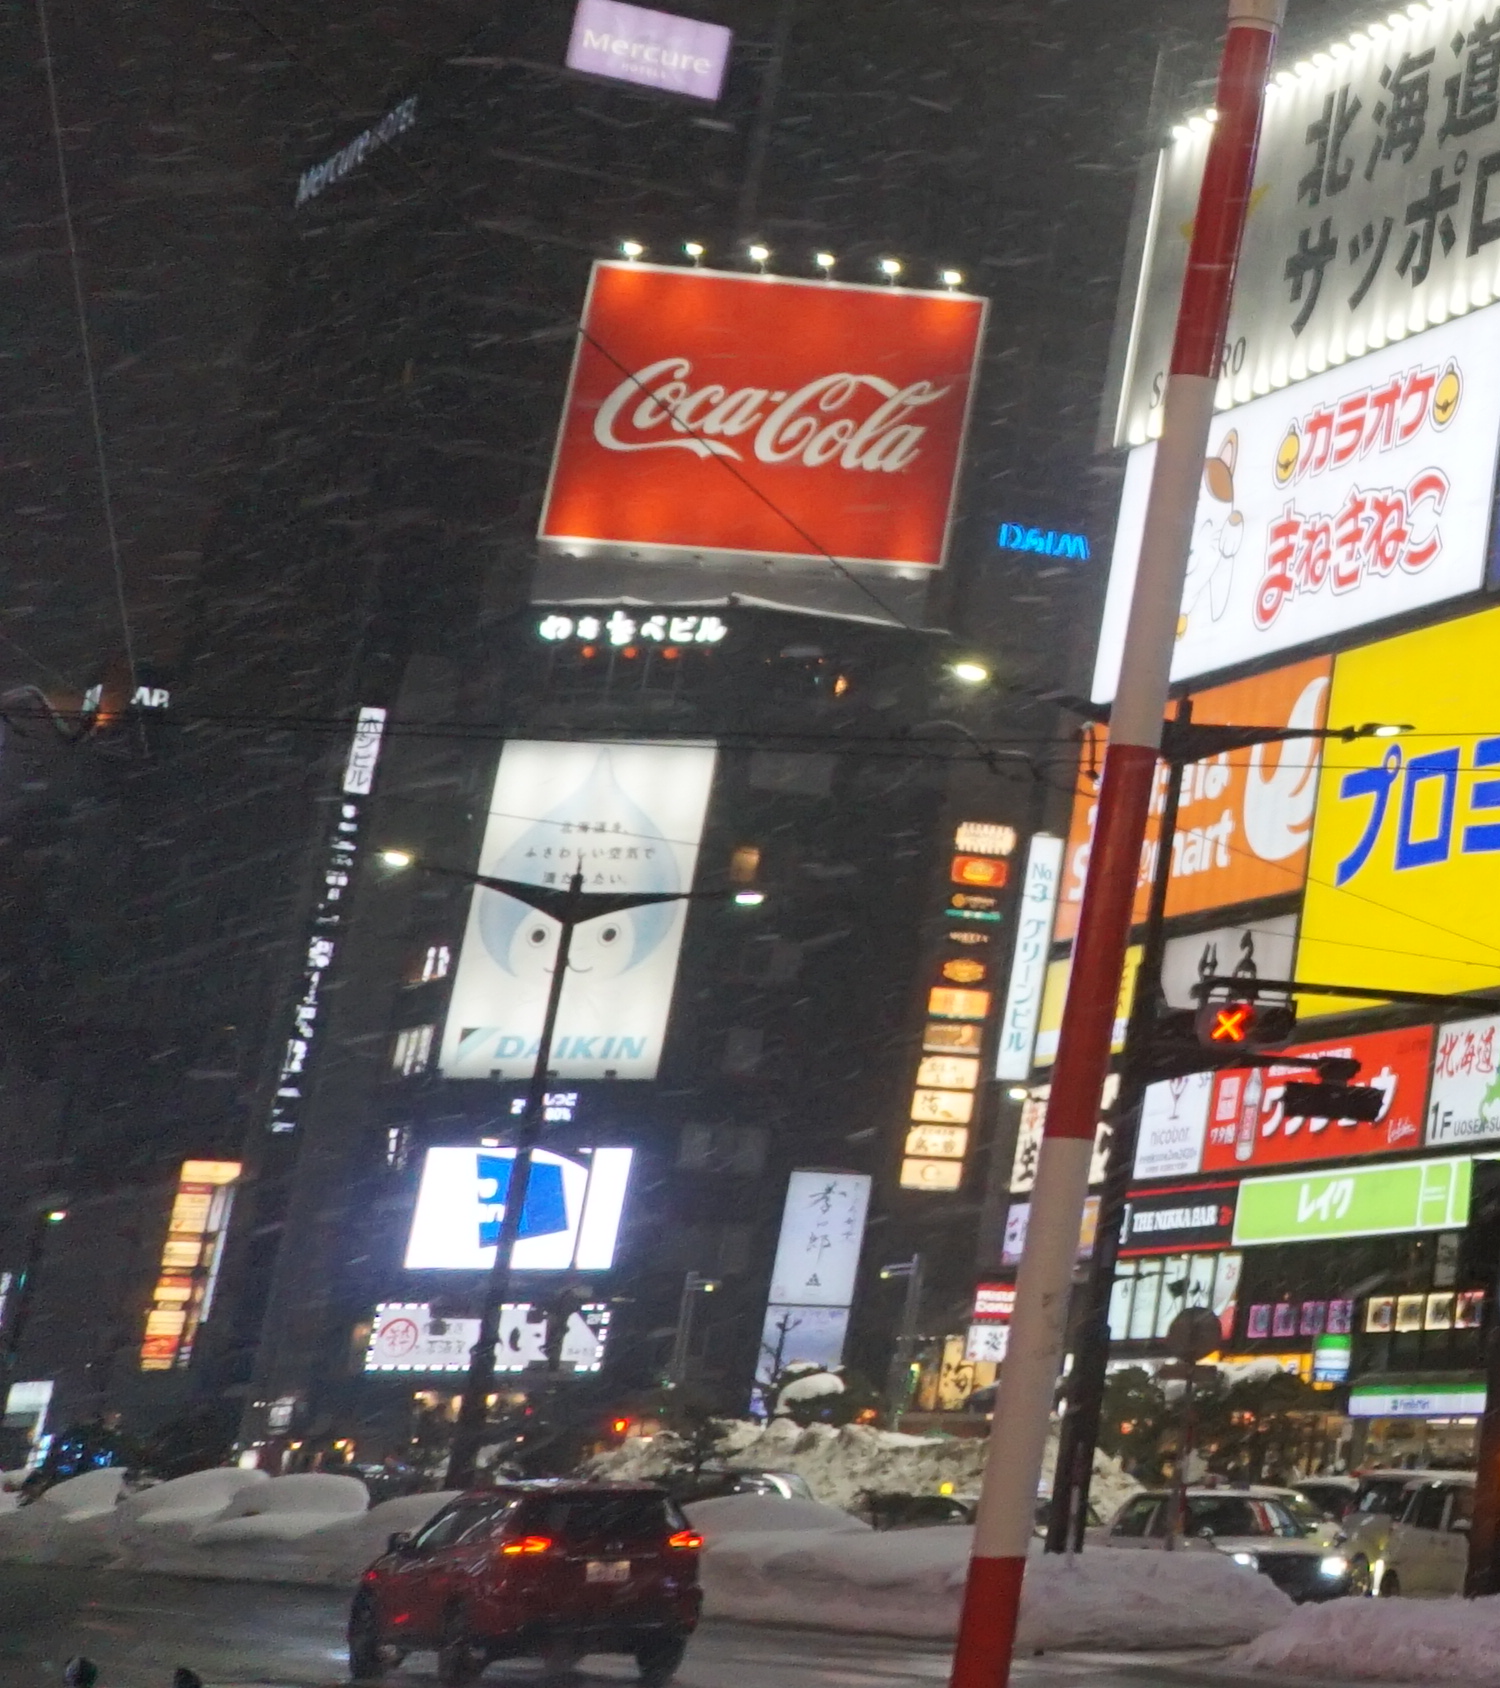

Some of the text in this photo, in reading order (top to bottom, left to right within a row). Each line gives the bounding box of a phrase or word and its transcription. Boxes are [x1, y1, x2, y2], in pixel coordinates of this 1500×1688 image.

[582, 28, 713, 77] Mercure
[593, 357, 951, 473] Coca-Cola
[1295, 368, 1441, 476] カラオケ
[1254, 467, 1452, 630] まねきねこ
[1004, 918, 1047, 1053] グリーンビル
[1435, 1005, 1496, 1079] 北海道
[1430, 1100, 1454, 1141] 1F
[1133, 1204, 1218, 1234] THE NIKKA BAR
[1297, 1177, 1355, 1223] レイク
